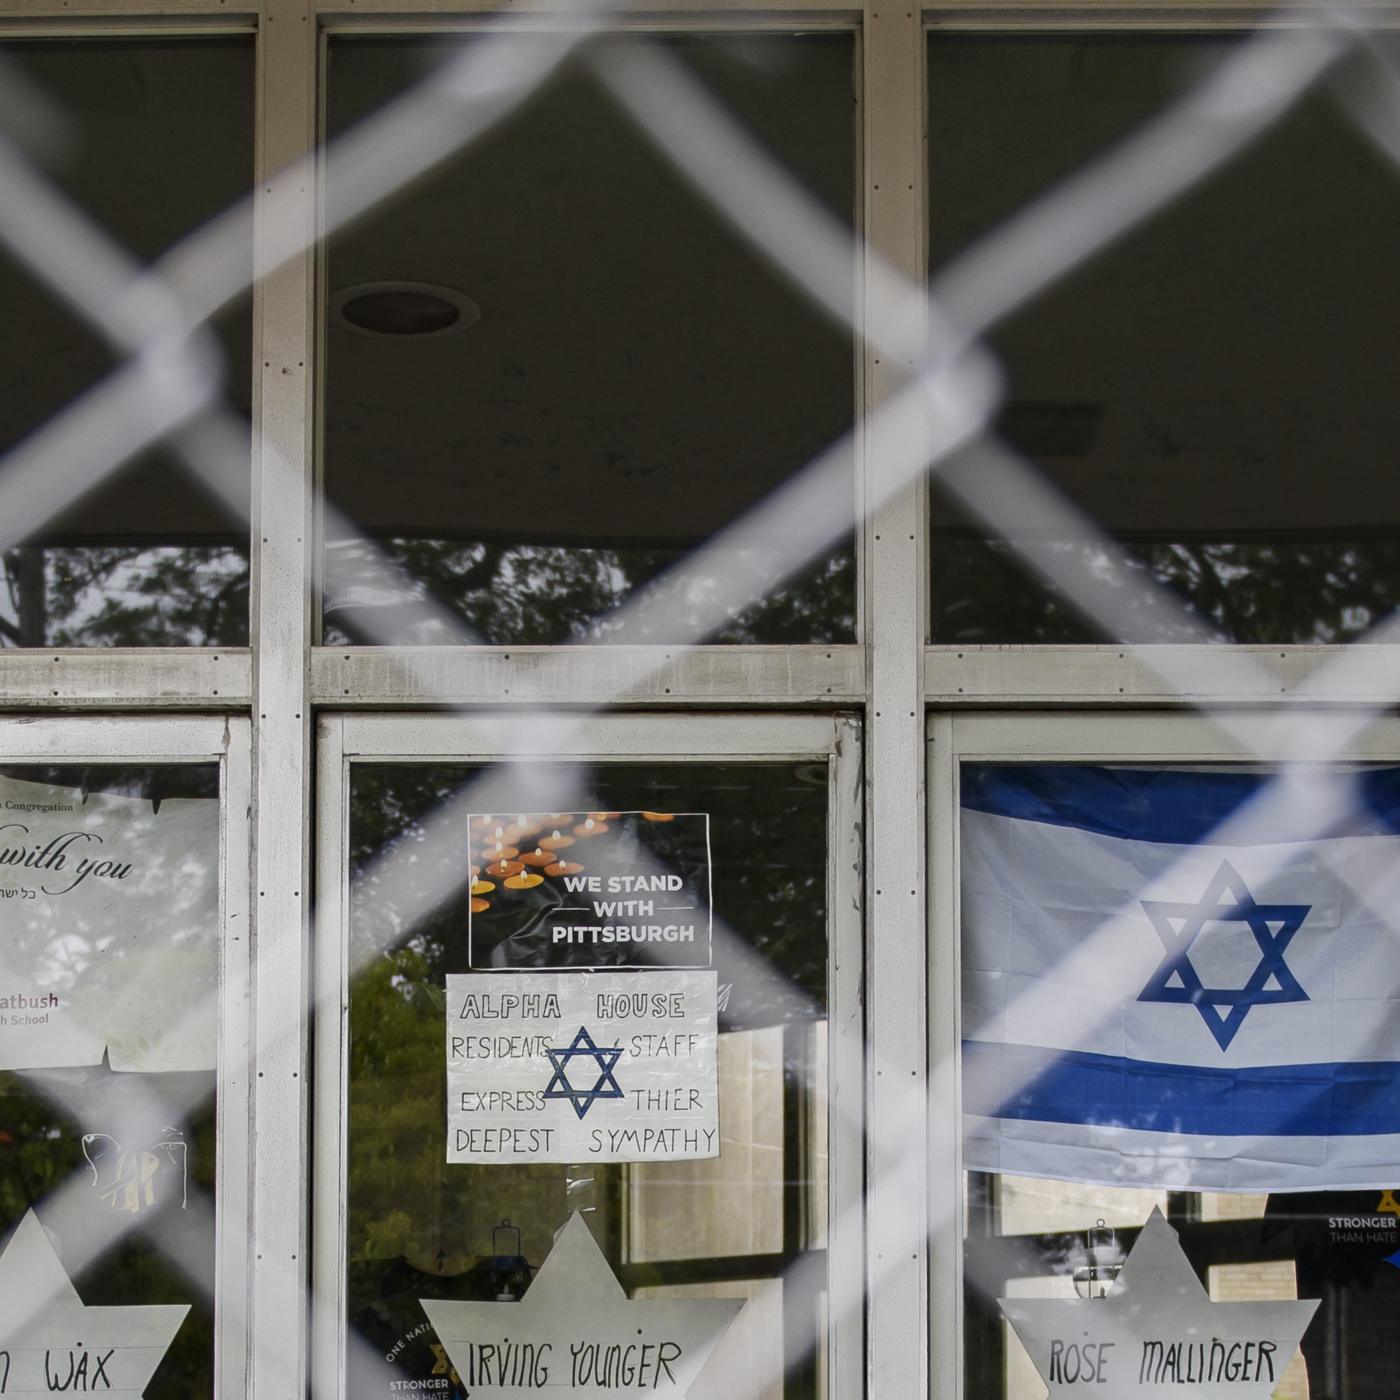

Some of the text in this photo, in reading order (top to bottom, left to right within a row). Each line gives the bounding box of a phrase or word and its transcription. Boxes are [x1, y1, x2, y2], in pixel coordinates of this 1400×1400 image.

[5, 801, 73, 813] Congregation
[41, 858, 133, 895] you
[564, 875, 683, 892] WE STAND
[22, 888, 36, 899] כל
[593, 900, 653, 917] WITH
[553, 926, 694, 943] PITTSBURGH
[460, 994, 684, 1019] ALPHA HOUSE
[10, 1014, 49, 1025] School
[452, 1035, 699, 1058] RESIDENTS STAFF
[461, 1090, 703, 1111] EXPRESS THIER
[457, 1129, 716, 1152] DEEPEST SYMPATHY
[1328, 1217, 1396, 1229] STRONGER
[45, 1349, 114, 1391] WAX
[469, 1341, 682, 1388] IRVING YOUNGER
[1050, 1340, 1277, 1384] ROSE MALLINGER
[389, 1379, 449, 1391] STRONGER
